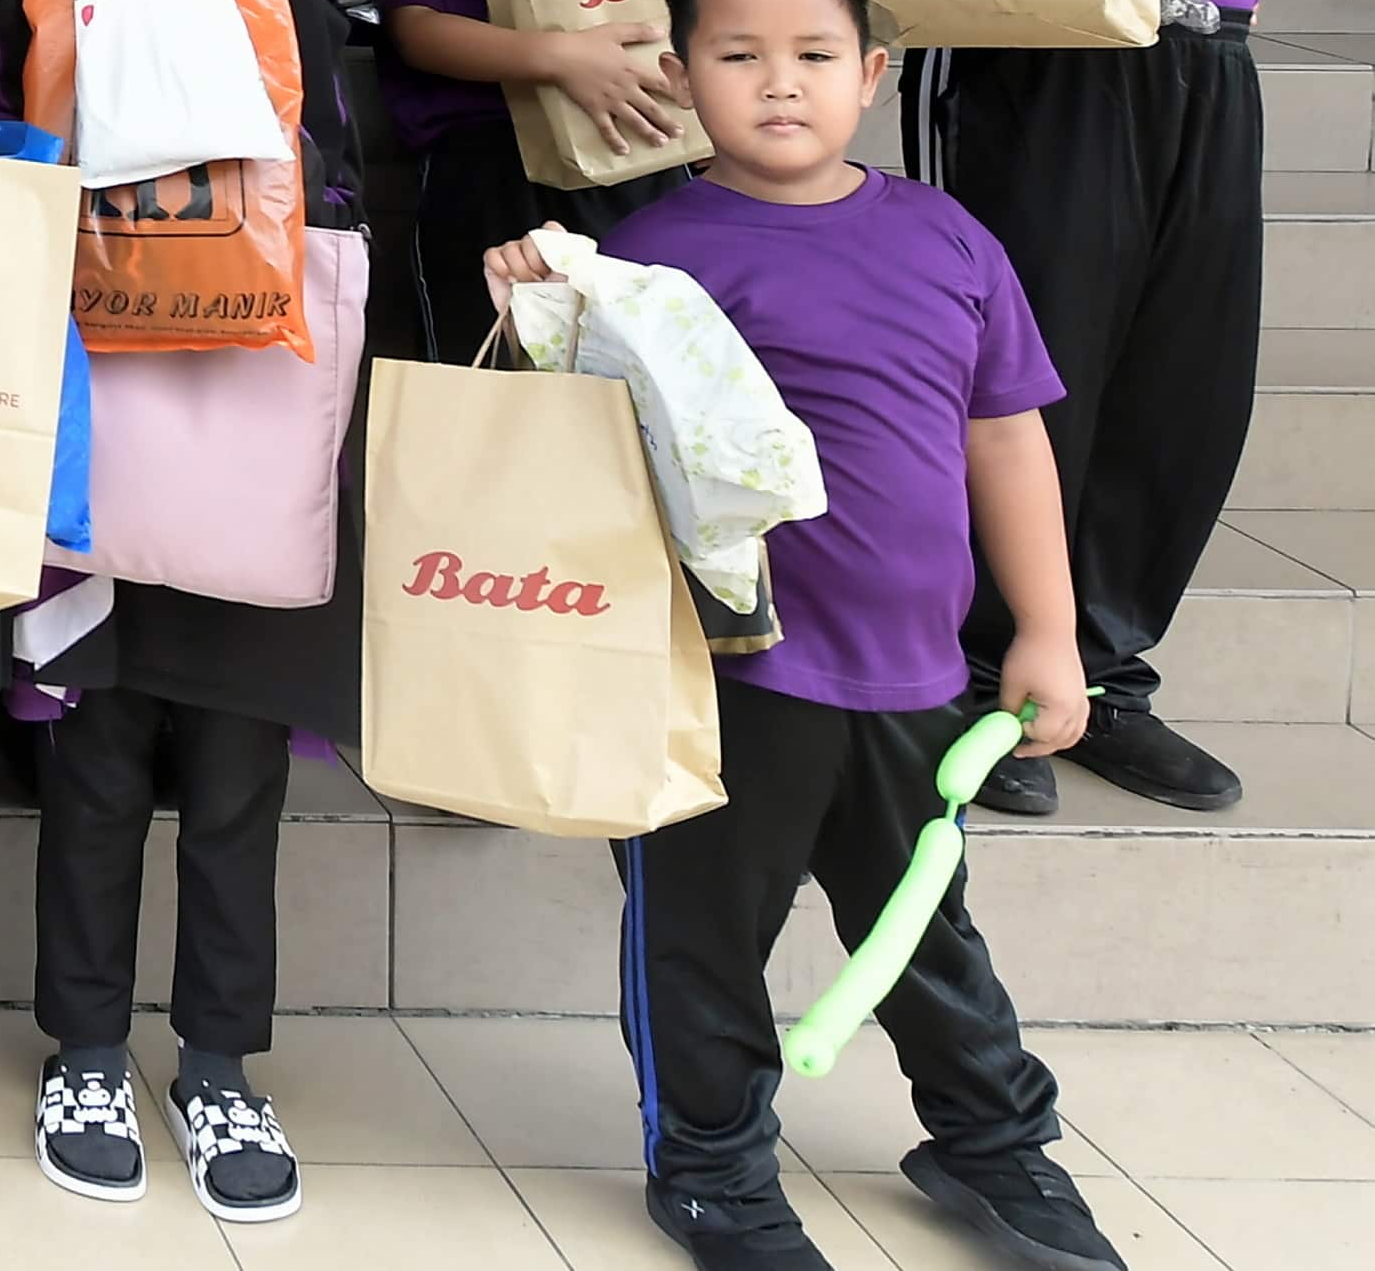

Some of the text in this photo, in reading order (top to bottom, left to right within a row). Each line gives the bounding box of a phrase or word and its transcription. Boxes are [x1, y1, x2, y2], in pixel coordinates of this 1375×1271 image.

[71, 288, 292, 320] YOR MANIK
[401, 550, 612, 618] Bata
